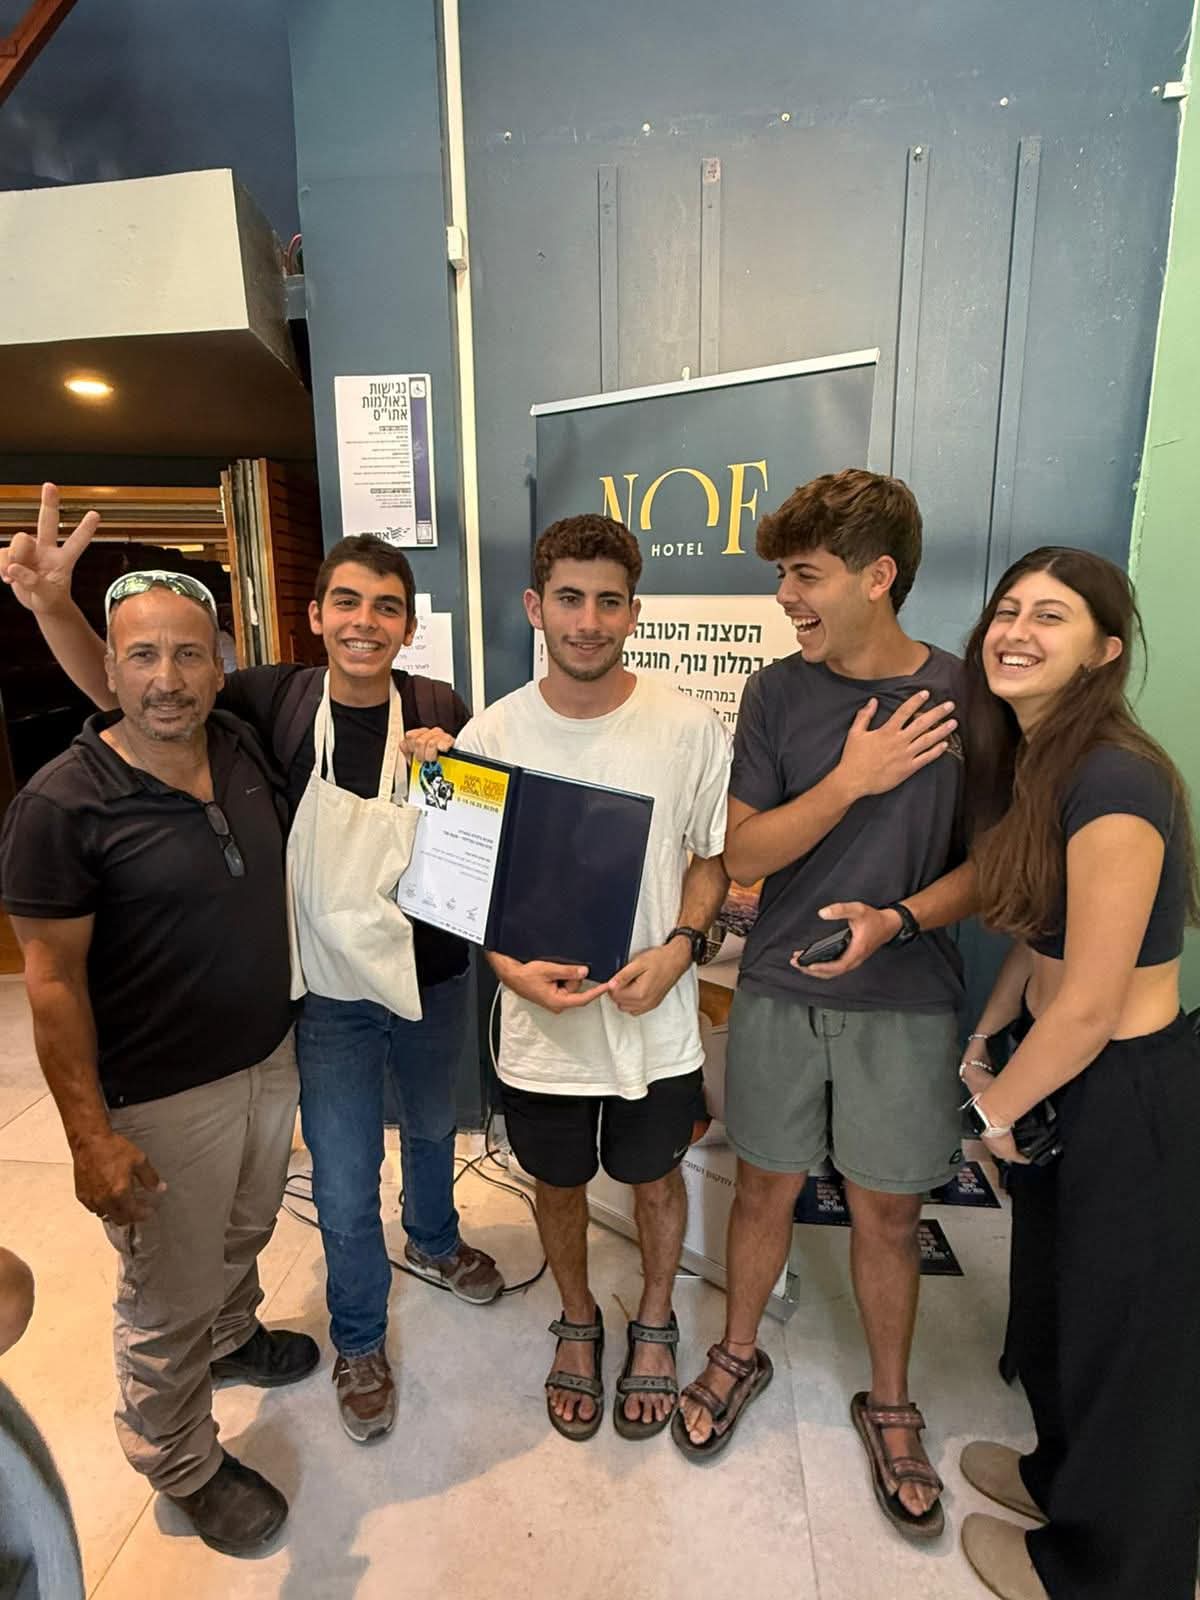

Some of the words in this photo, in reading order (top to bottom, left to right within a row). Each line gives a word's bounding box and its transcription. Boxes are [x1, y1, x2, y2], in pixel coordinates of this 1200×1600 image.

[370, 382, 406, 395] נגישות
[362, 392, 407, 408] באולמות
[599, 460, 768, 555] NOF
[651, 542, 704, 557] HOTEL
[634, 622, 690, 641] הטובה
[696, 623, 762, 643] הסצנה
[674, 651, 707, 675] נוף,
[696, 688, 736, 703] במרחק
